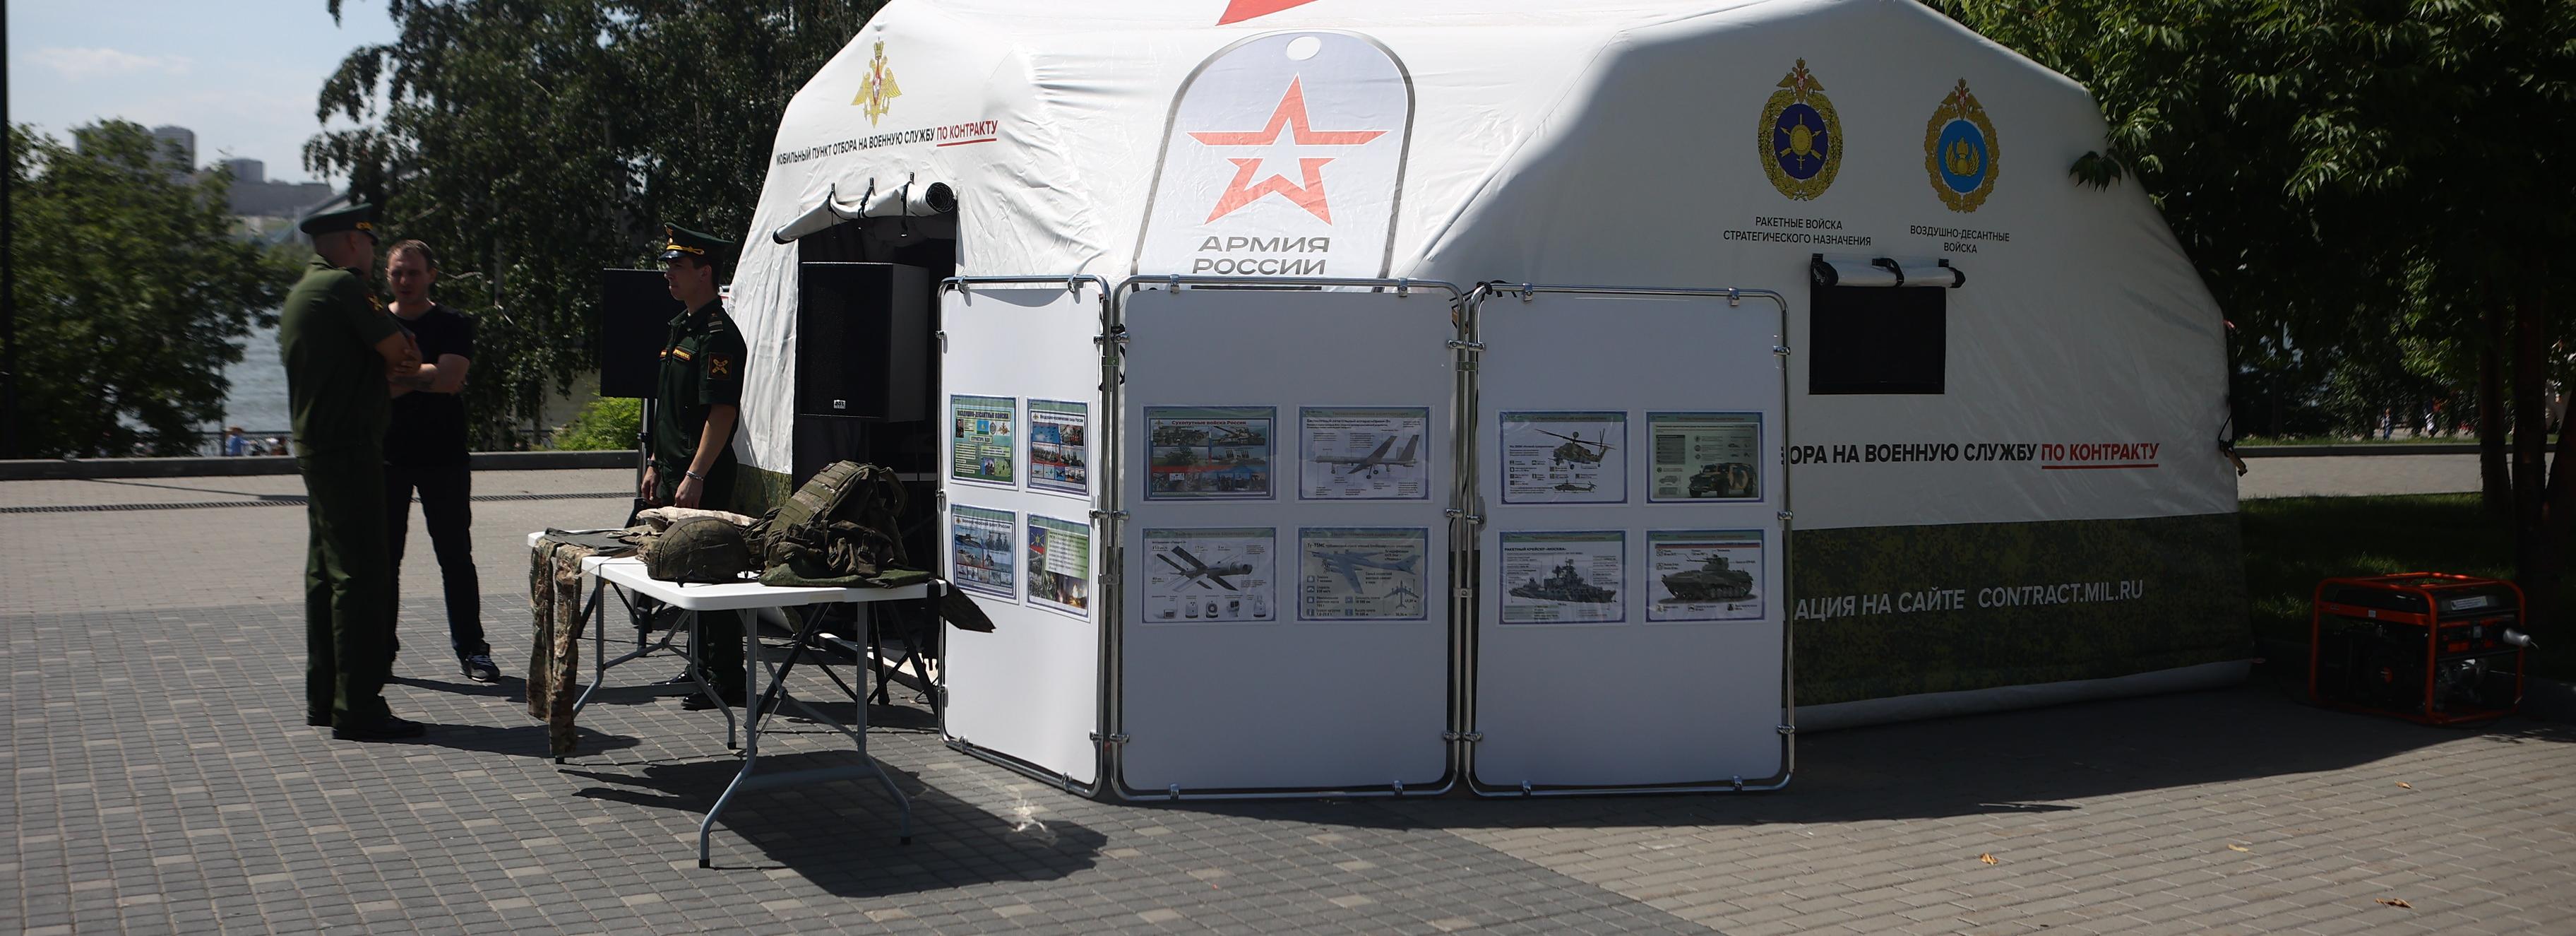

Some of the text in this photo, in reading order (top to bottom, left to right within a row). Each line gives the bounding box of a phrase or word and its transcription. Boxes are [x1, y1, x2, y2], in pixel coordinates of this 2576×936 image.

[777, 120, 998, 166] МОБИЛЬНЫЙ ПУНКТ ОТБОРА НА ВОЕННУЮ СЛУЖБУ ПО КОНТРАКТУ
[1755, 216, 1842, 230] РАКЕТНЫЕ ВОЙСКА
[1723, 230, 1871, 247] СТРАТЕГИЧЕСКОГО НАЗНАЧЕНИЯ
[1910, 225, 2010, 242] ВОЗДУШНО-ДЕСАНТНЫЕ
[1198, 236, 1330, 253] АРМИЯ
[1943, 240, 1977, 254] ВОЙСКА
[1192, 258, 1326, 276] РОССИИ
[1781, 442, 2160, 465] ОРА НА ВОЕННУЮ СЛУЖБУ ПО КОНТРАКТУ
[1794, 579, 2143, 622] АЦИЯ НА САЙТЕ CONTRACT.MIL.RU
